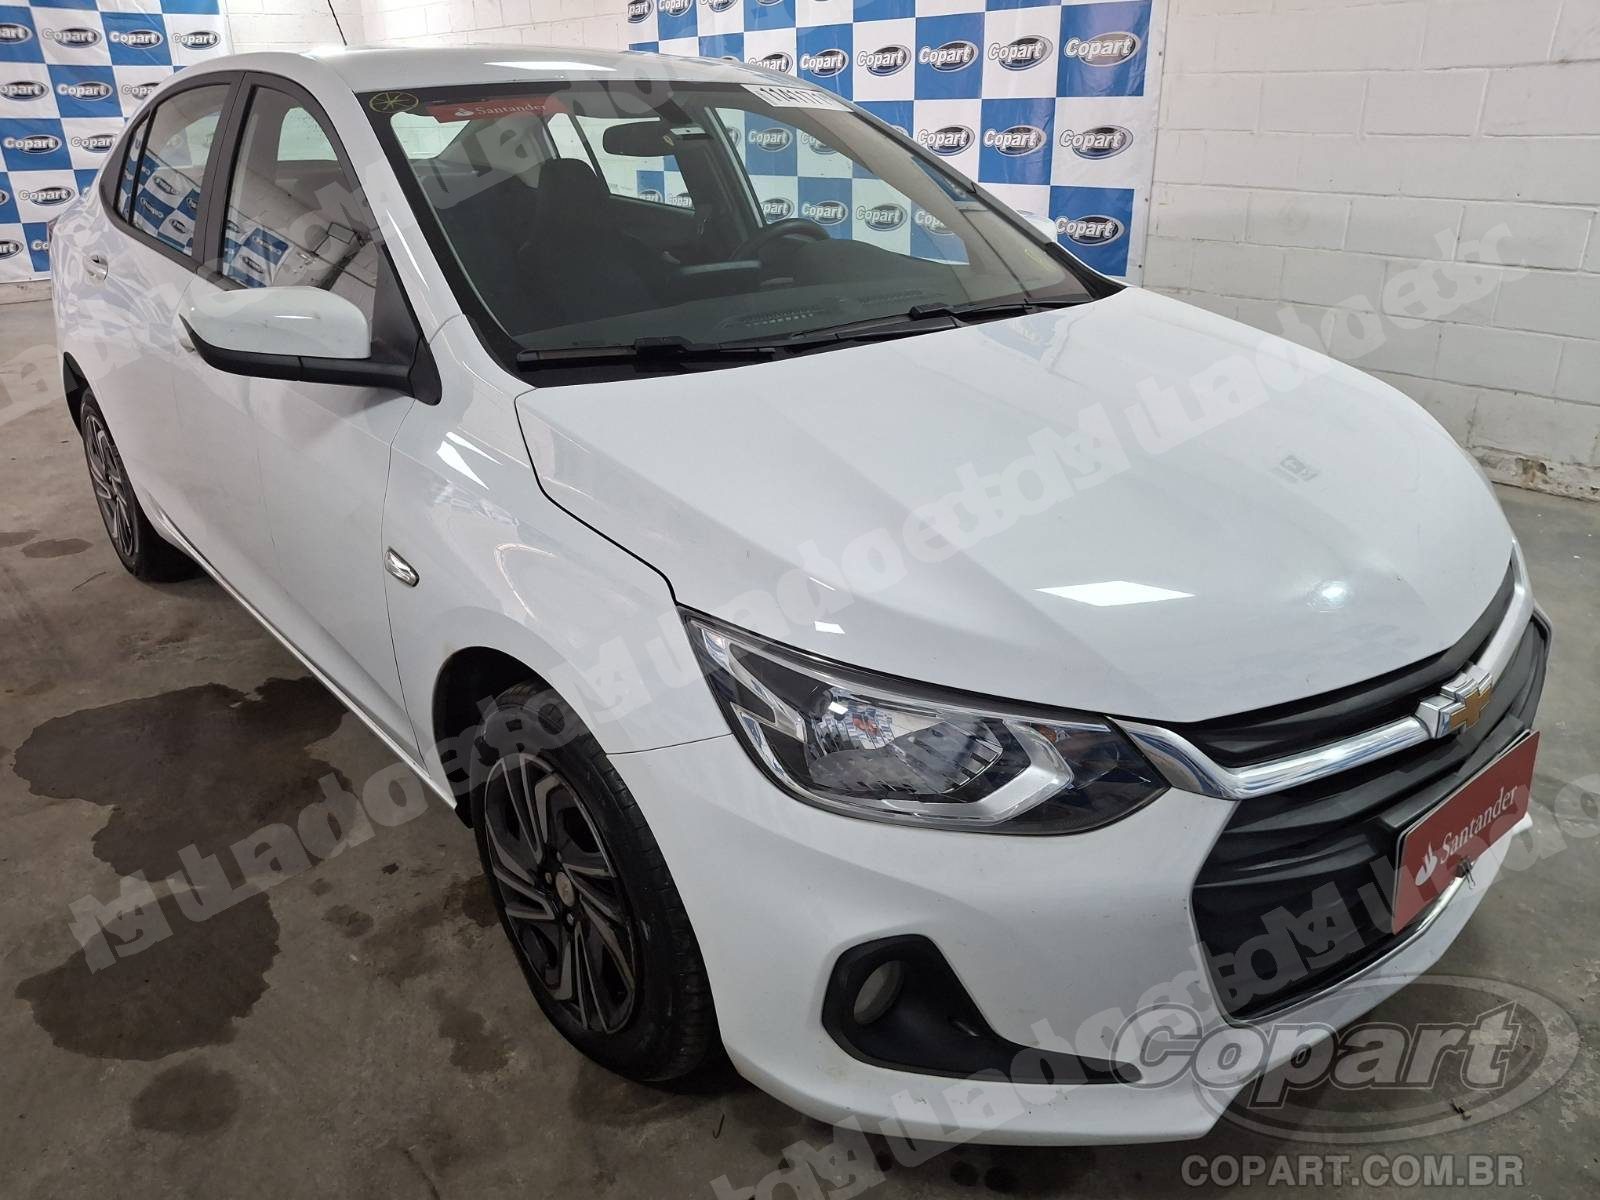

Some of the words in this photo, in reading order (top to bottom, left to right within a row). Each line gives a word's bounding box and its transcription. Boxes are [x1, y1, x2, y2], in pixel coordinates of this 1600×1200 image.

[628, 0, 649, 16] part
[0, 26, 25, 39] art
[42, 28, 95, 44] Copart
[109, 31, 157, 45] Copart
[172, 32, 216, 46] Copart
[918, 45, 974, 64] Copart
[987, 40, 1043, 62] Copart
[1064, 37, 1132, 59] Copart
[801, 53, 843, 73] Copart
[857, 48, 905, 68] Copart
[0, 84, 41, 98] opart
[57, 82, 107, 98] Copart
[121, 84, 153, 97] Copa
[475, 103, 546, 115] Santander
[4, 136, 56, 150] Copart
[748, 129, 788, 146] Copart
[916, 128, 970, 148] Copart
[983, 129, 1037, 148] Copart
[1058, 129, 1123, 150] Copart
[18, 189, 69, 202] Copart
[761, 201, 787, 217] part
[802, 202, 844, 220] Copart
[856, 206, 902, 224] Copart
[914, 209, 946, 228] Cop
[1055, 216, 1117, 238] Copart
[1439, 784, 1519, 864] Santander
